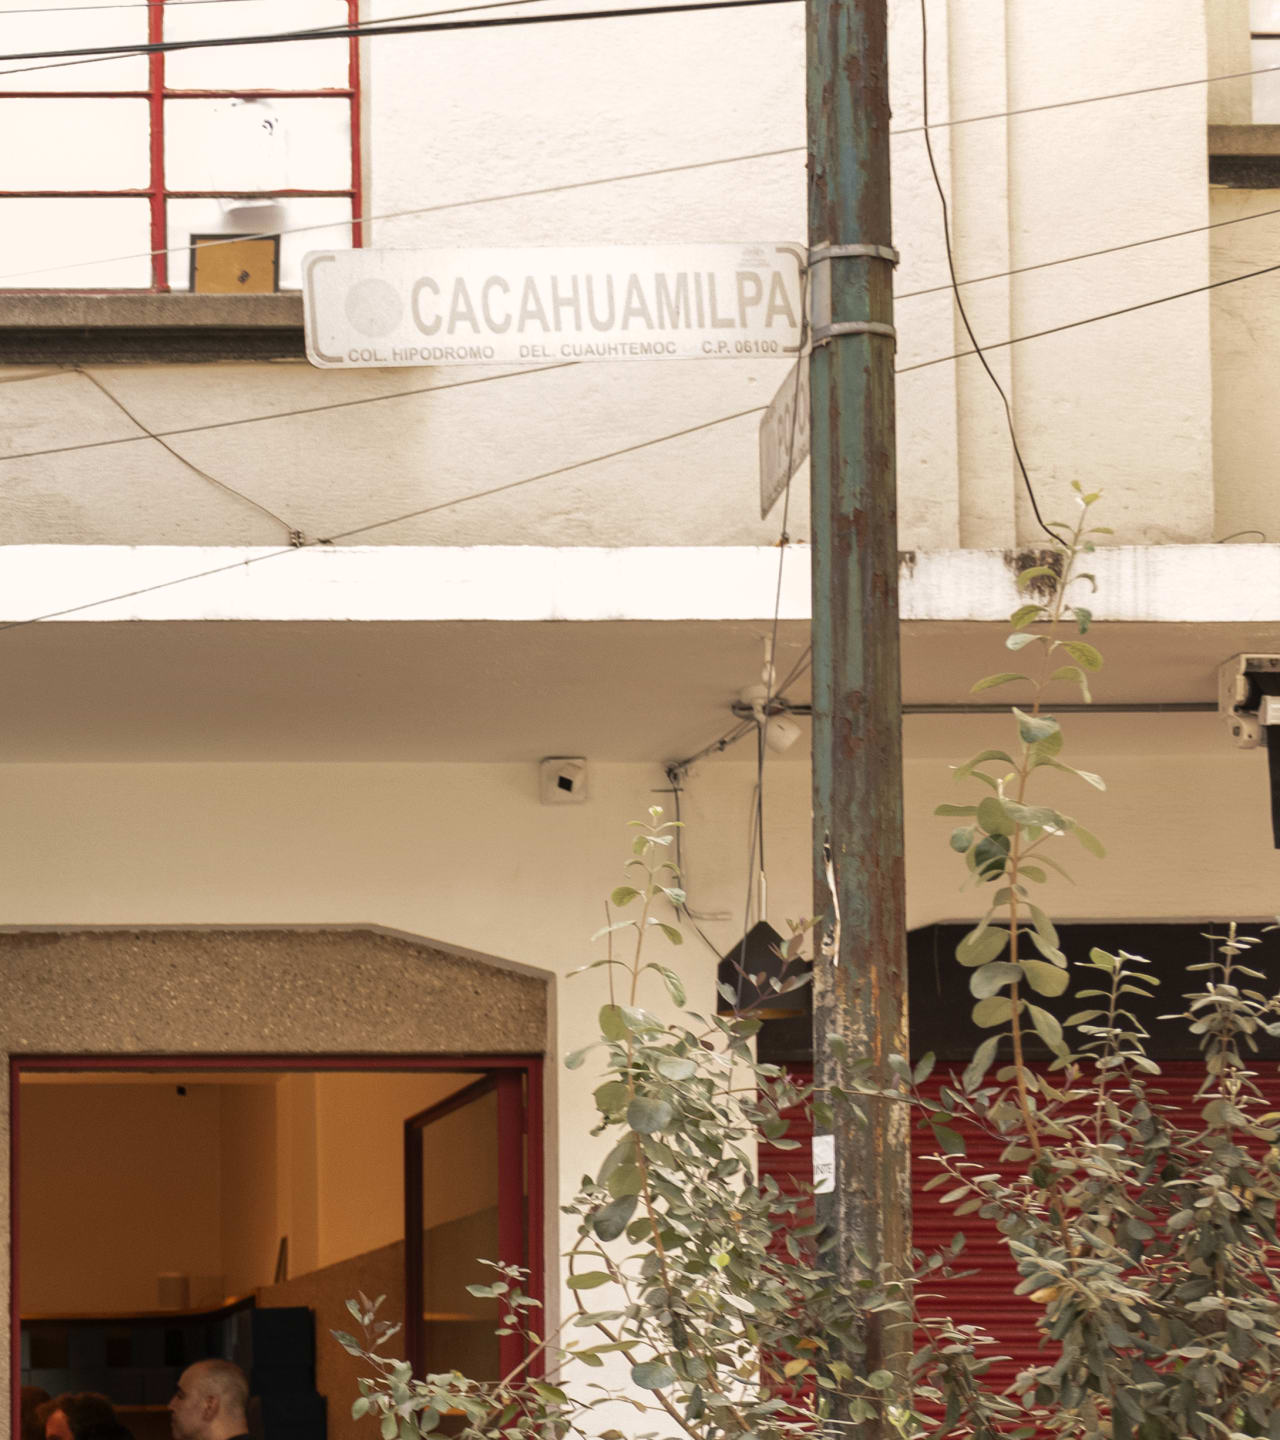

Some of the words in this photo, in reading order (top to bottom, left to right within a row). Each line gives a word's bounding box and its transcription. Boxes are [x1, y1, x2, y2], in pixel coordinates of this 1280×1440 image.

[411, 271, 798, 336] CACAHUAMILPA
[348, 348, 387, 362] COL.
[393, 346, 495, 361] HIPODROMO
[519, 344, 556, 358] DEL.
[561, 341, 677, 358] CUAUHTEMOC
[702, 340, 731, 353] C.P.
[735, 340, 778, 353] 06100
